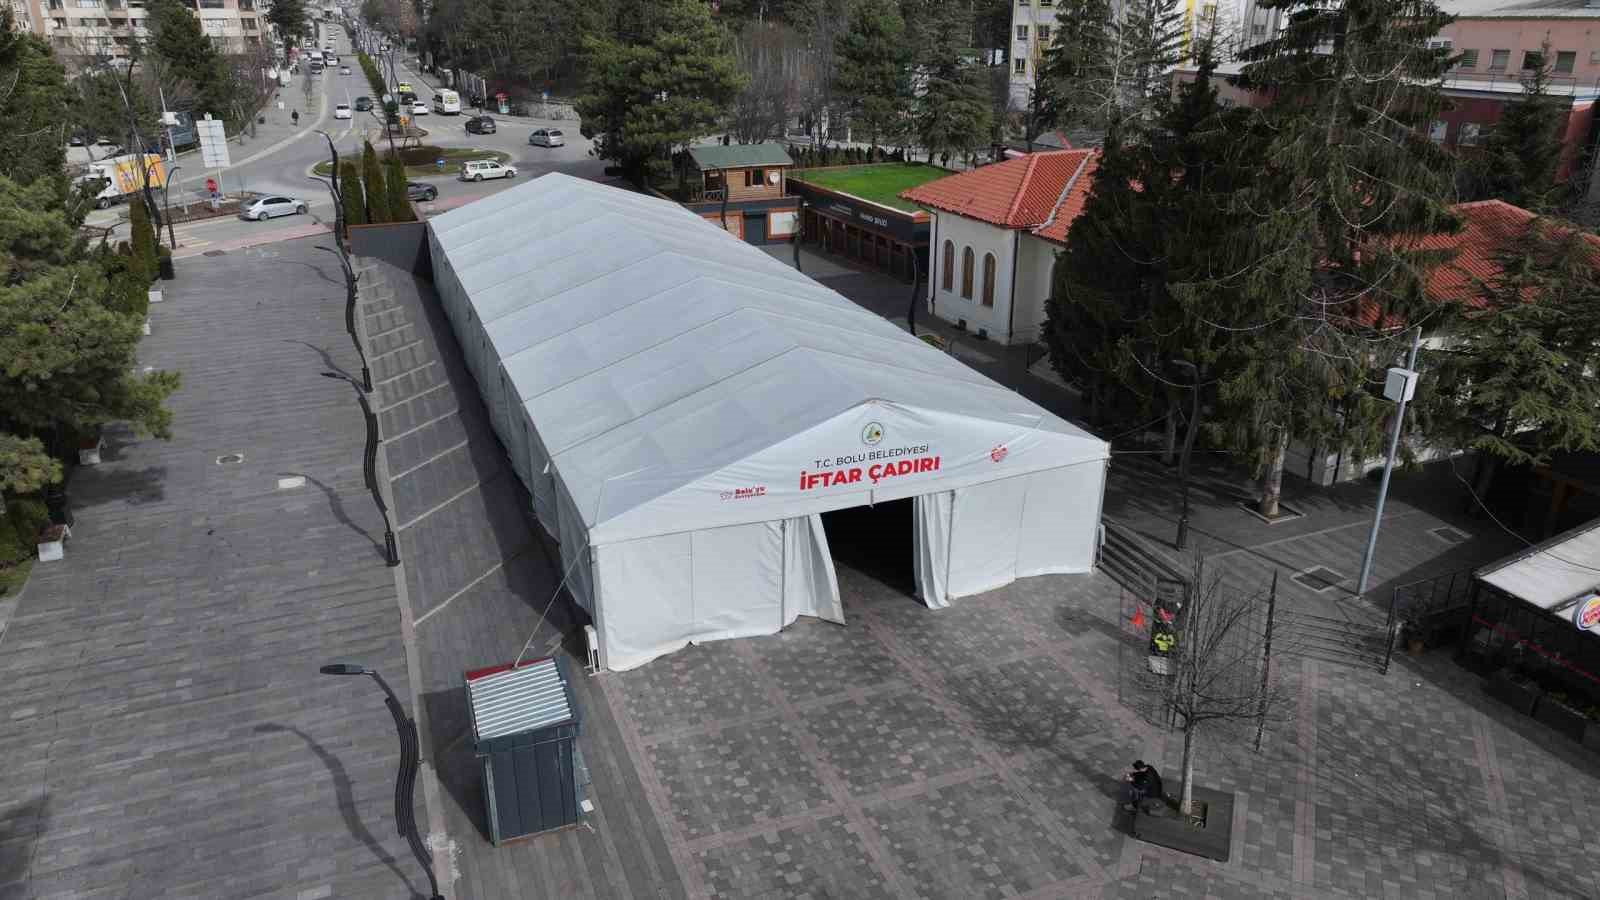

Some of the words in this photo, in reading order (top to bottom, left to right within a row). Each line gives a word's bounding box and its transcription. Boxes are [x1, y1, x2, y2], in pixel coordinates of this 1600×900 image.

[815, 459, 833, 469] T.C.
[836, 454, 866, 467] BOLU
[869, 443, 929, 460] BELEDİYESİ
[800, 470, 862, 490] İFTAR
[868, 456, 940, 484] ÇADIRI
